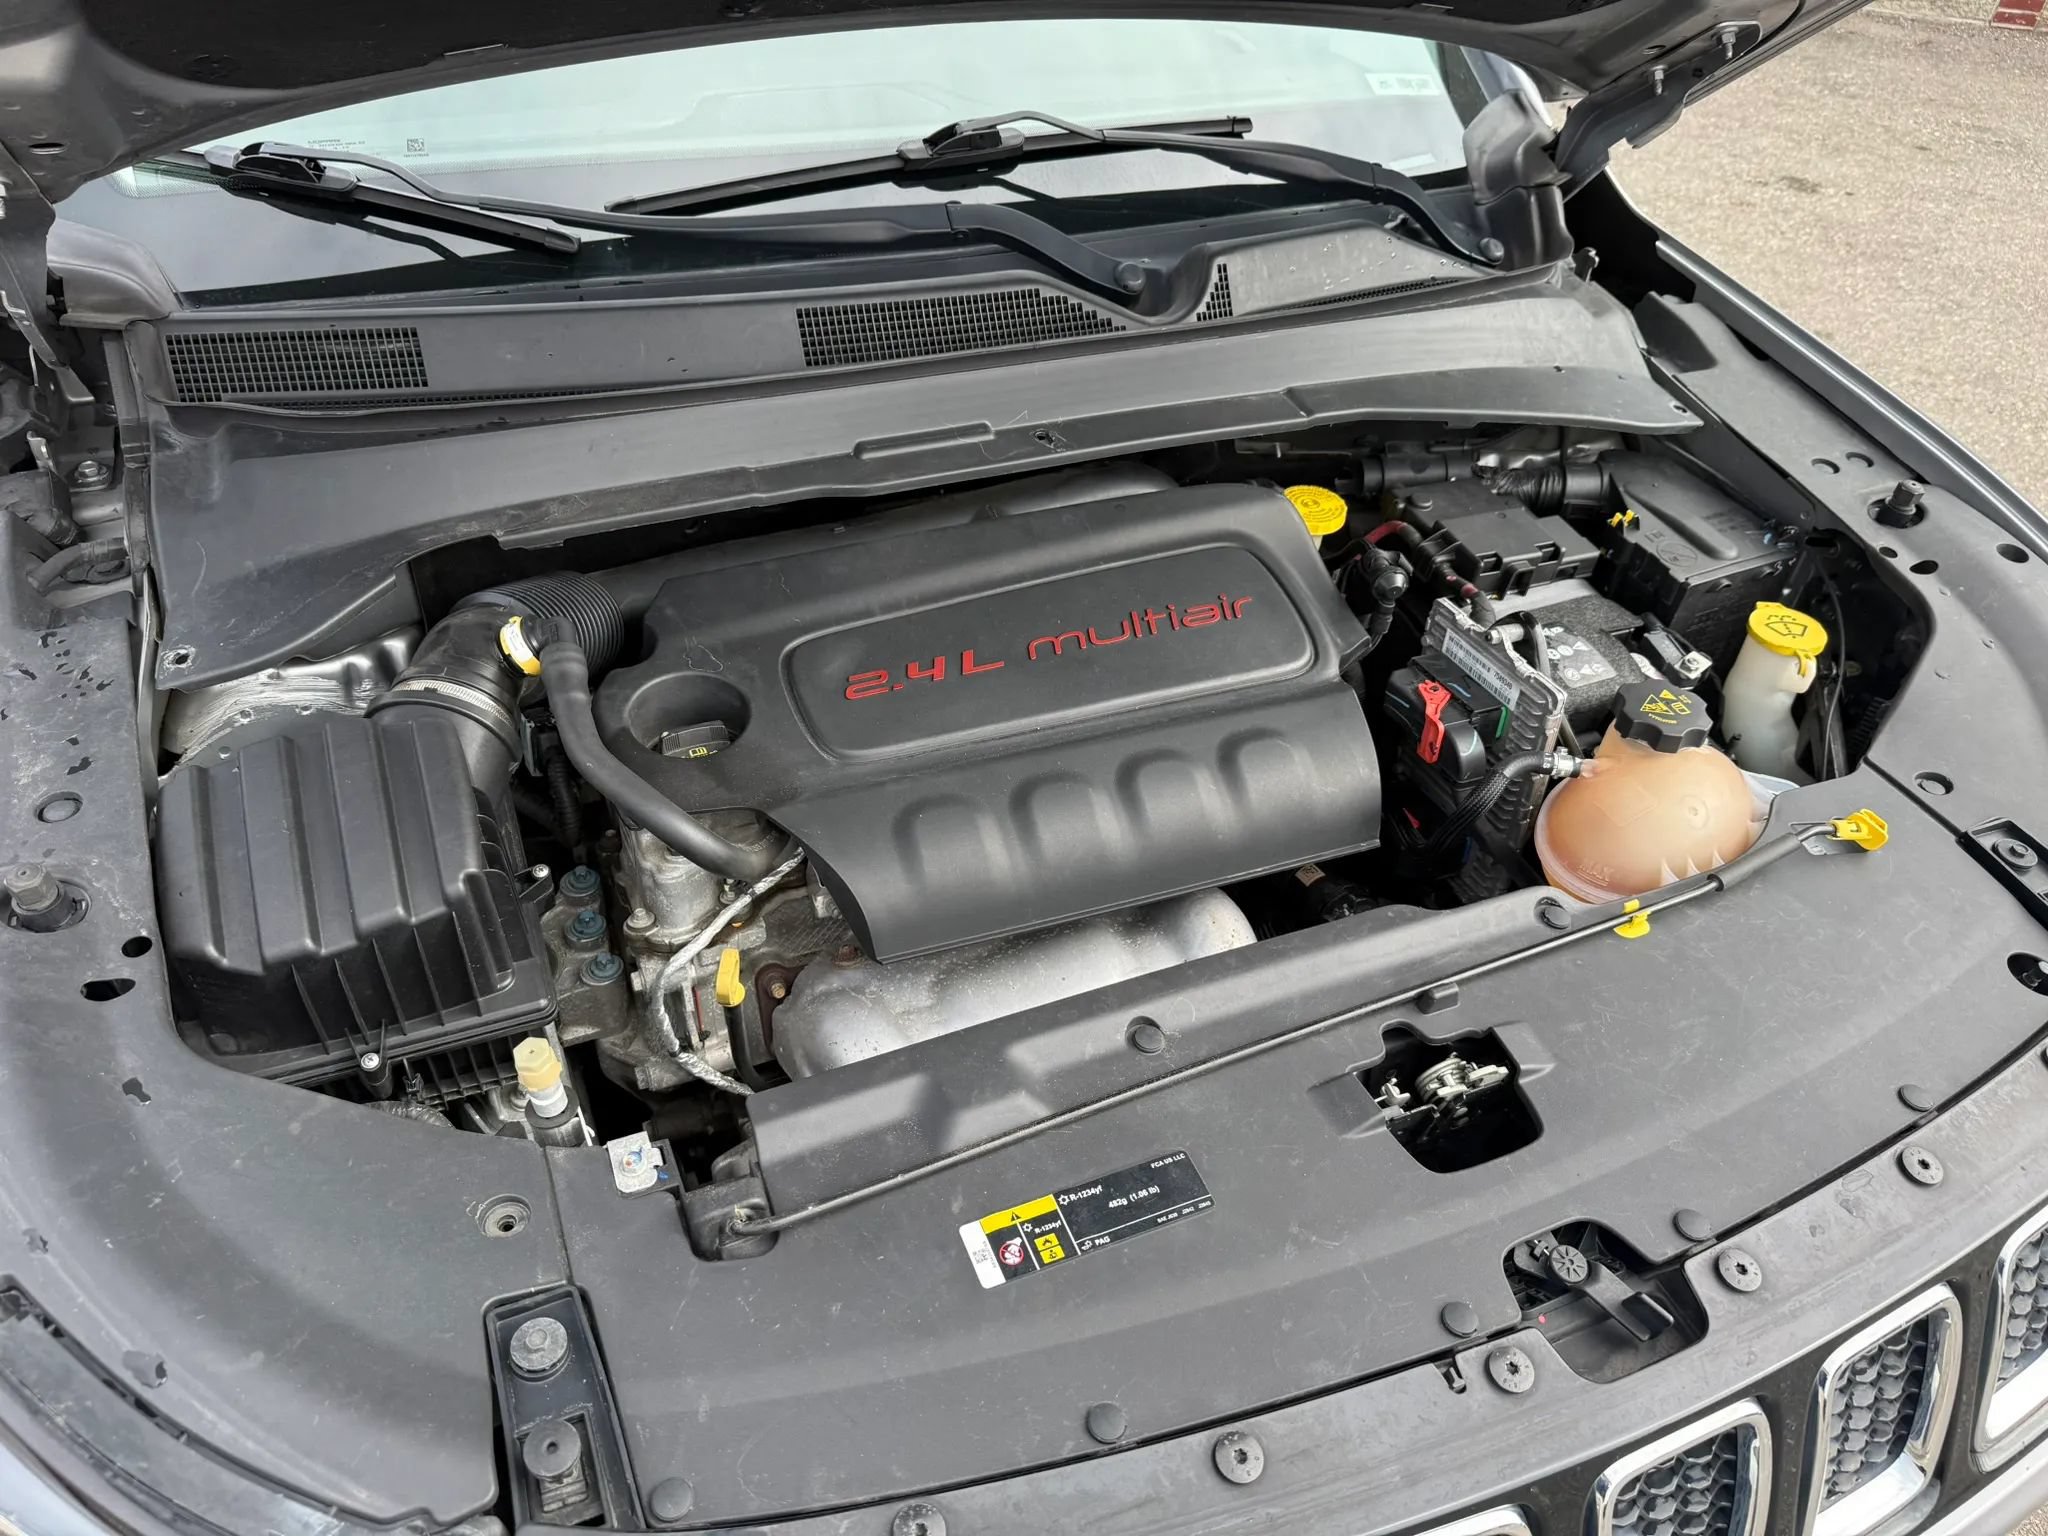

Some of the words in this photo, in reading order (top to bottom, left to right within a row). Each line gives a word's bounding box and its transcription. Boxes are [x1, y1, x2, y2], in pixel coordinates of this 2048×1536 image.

[844, 656, 946, 701] 2.4
[961, 648, 1005, 676] L
[1027, 593, 1254, 660] multiair
[1150, 1159, 1164, 1169] FCA
[1163, 1155, 1174, 1165] US
[1172, 1153, 1186, 1162] LLC
[1068, 1184, 1103, 1202] R-1234yf
[1108, 1197, 1128, 1209] 482g
[1148, 1185, 1161, 1195] lb)
[1034, 1219, 1062, 1234] R-1234yf
[1094, 1235, 1111, 1246] PAG
